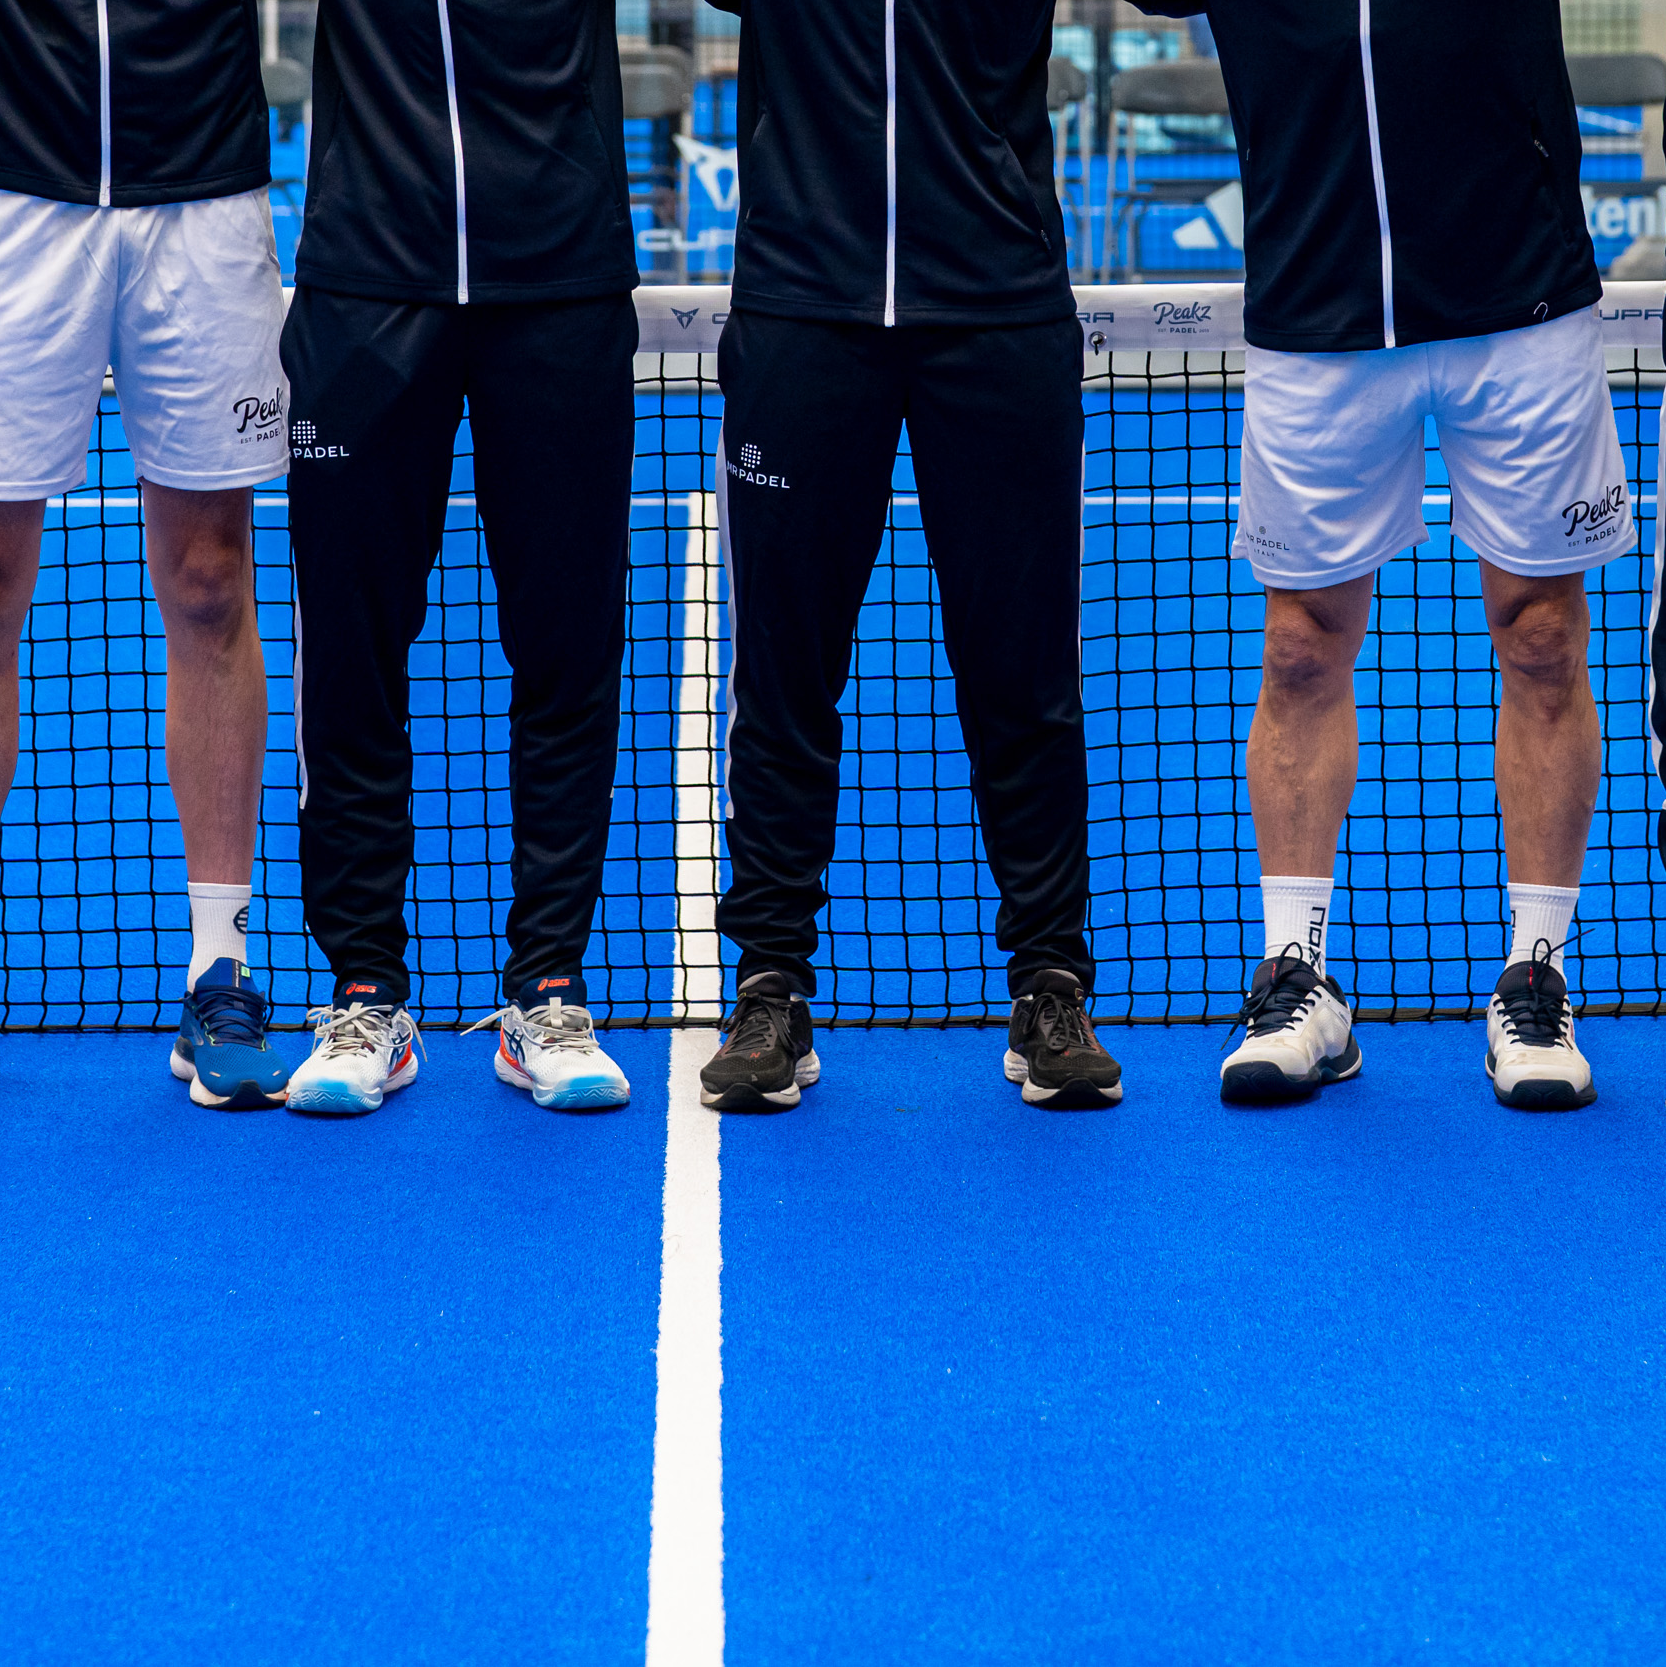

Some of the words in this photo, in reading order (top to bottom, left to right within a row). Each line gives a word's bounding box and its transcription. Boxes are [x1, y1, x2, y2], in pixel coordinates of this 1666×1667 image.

[1153, 301, 1212, 325] Peakz
[1599, 308, 1664, 321] UPR
[233, 387, 284, 433] Peak
[256, 428, 281, 442] PADE
[293, 445, 350, 459] PADEL
[738, 468, 791, 489] PADEL
[1561, 484, 1626, 537] Peakz
[1256, 537, 1290, 551] PADEL
[1585, 525, 1617, 545] PADEL
